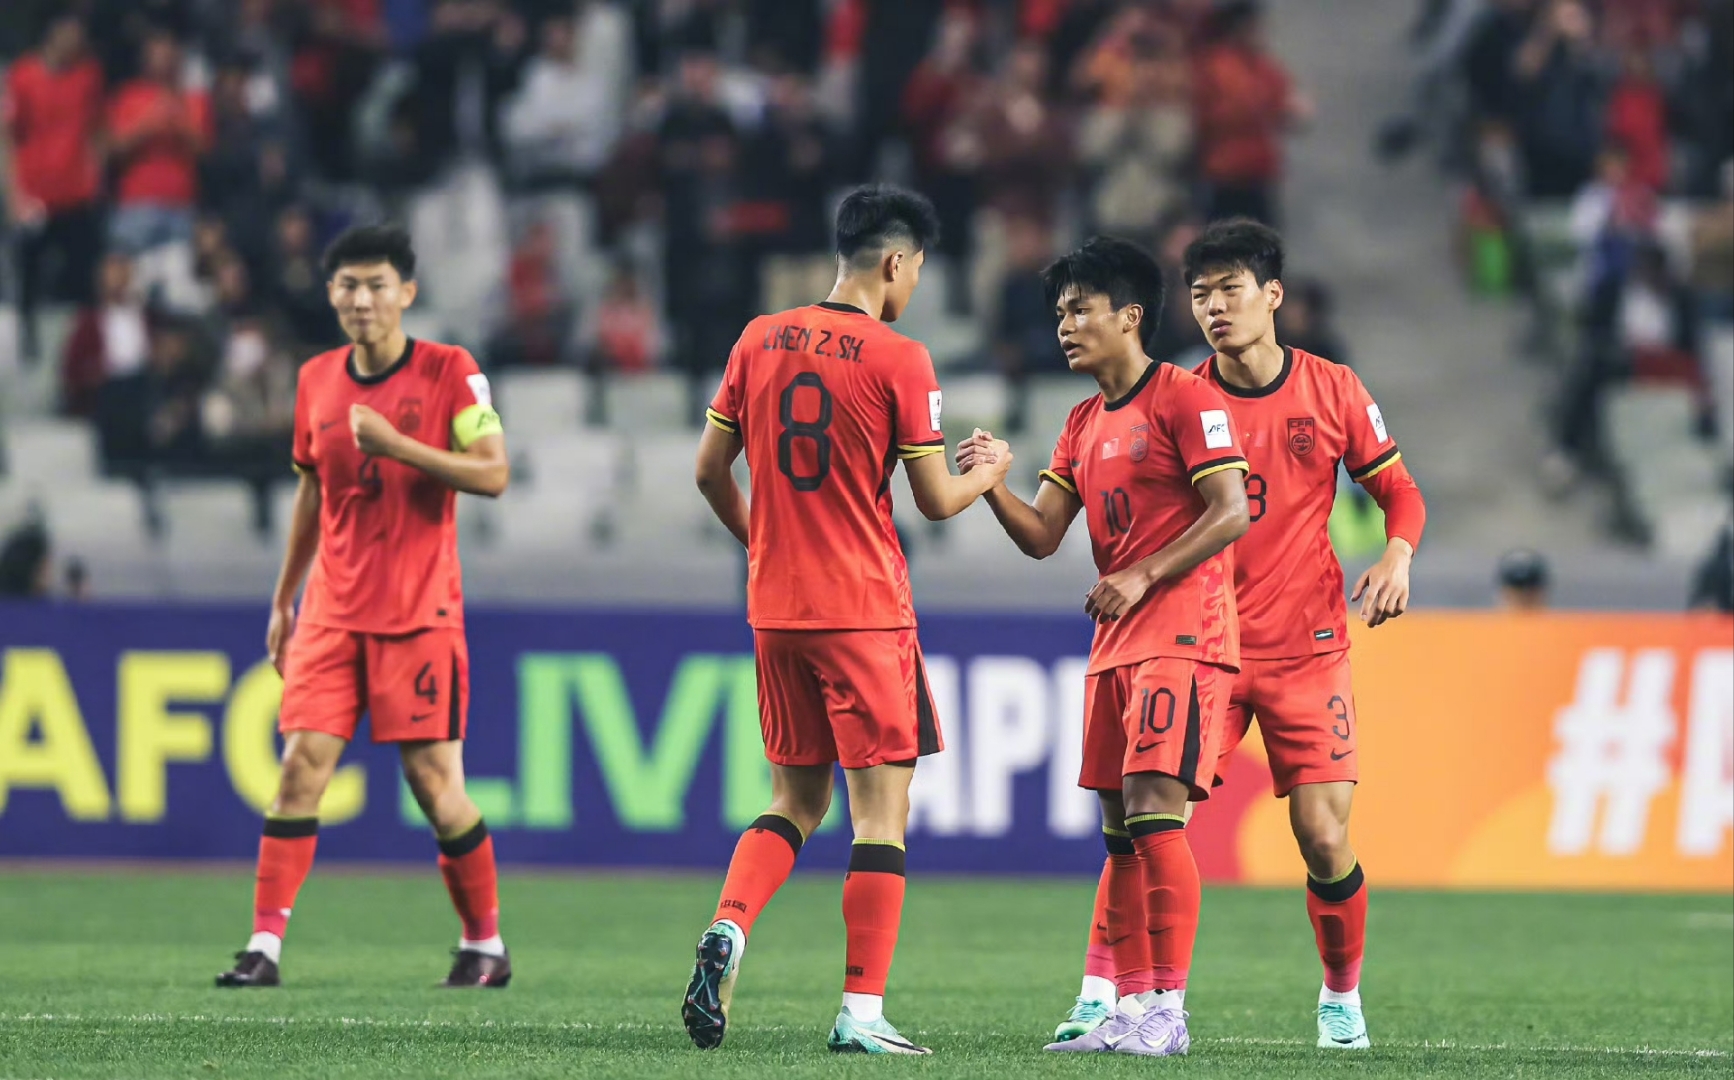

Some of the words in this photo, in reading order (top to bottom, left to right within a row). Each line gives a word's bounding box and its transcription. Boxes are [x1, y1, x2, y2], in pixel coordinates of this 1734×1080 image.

[763, 325, 812, 352] CHEN
[836, 334, 864, 363] SH.
[778, 371, 832, 492] 8
[1101, 487, 1132, 537] 10
[414, 661, 438, 706] 4
[1139, 687, 1176, 734] 10
[1327, 695, 1350, 740] 3
[0, 647, 367, 827] AFC
